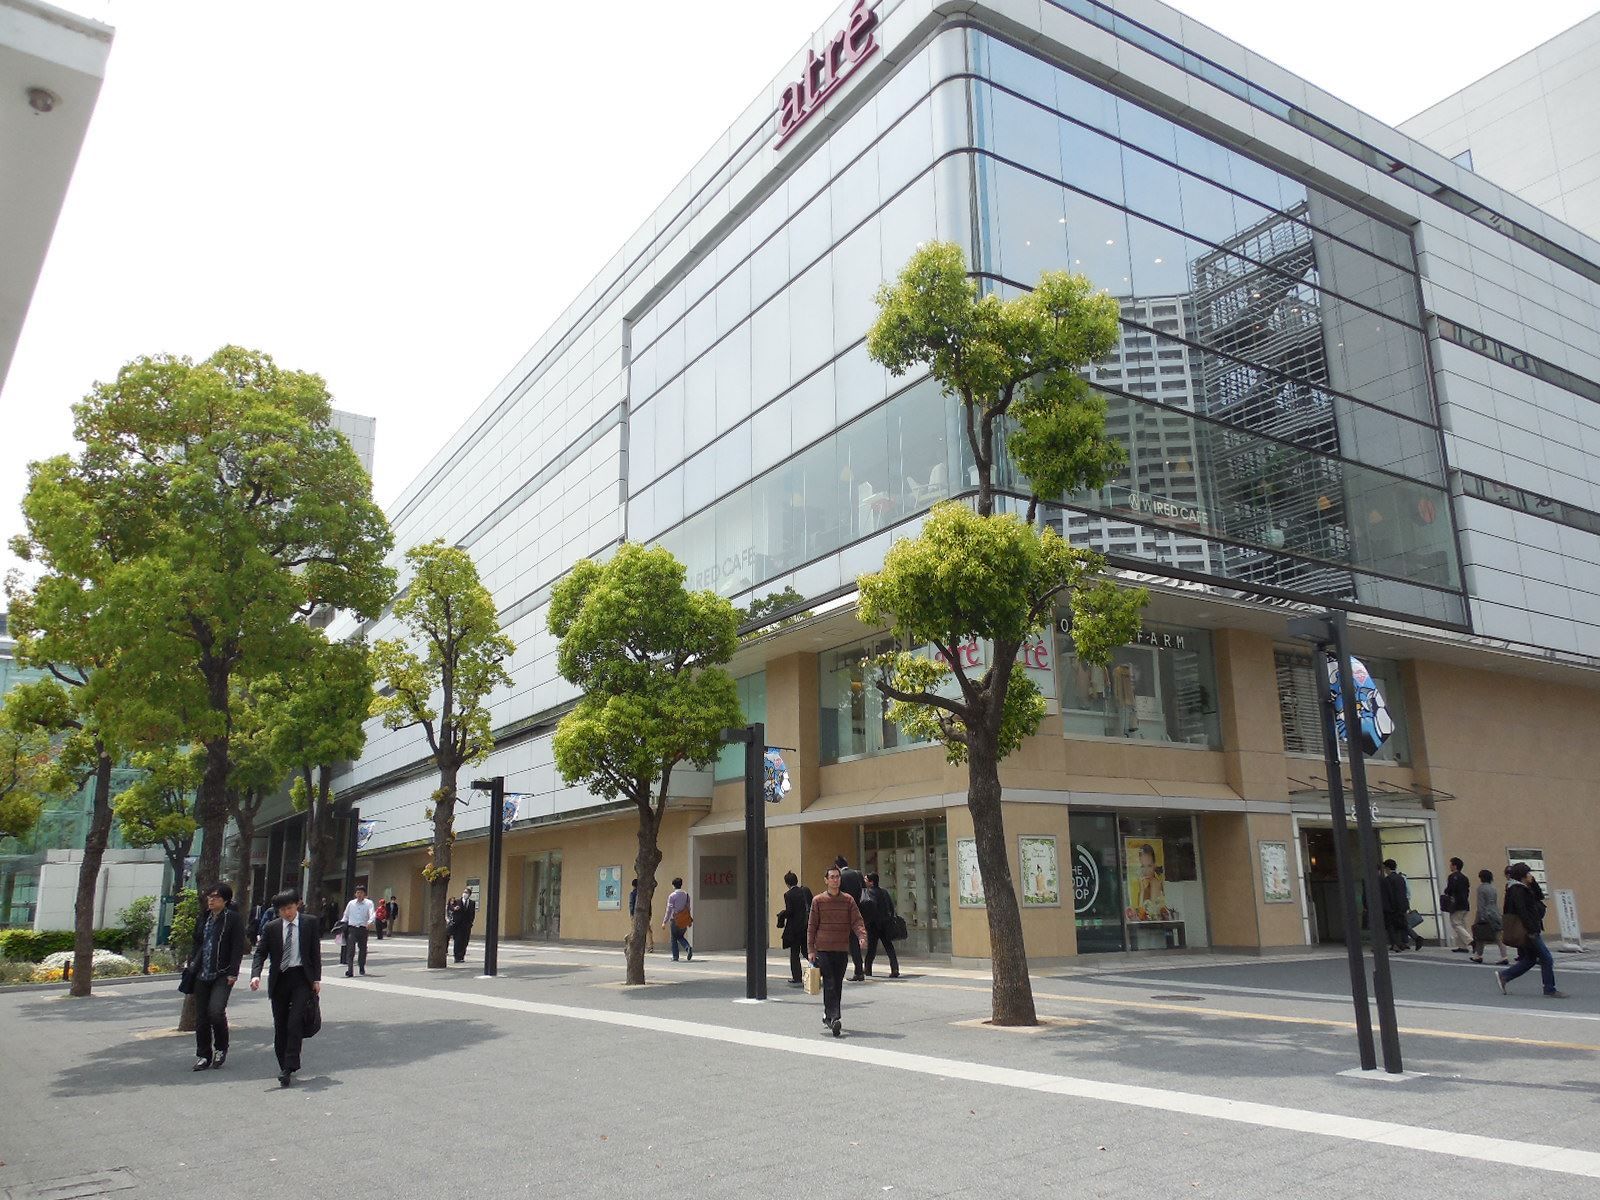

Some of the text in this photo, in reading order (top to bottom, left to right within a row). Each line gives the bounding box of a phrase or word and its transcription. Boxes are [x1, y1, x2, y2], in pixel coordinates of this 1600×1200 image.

[1142, 498, 1209, 525] WIRED CAFE
[1137, 630, 1185, 650] FARM
